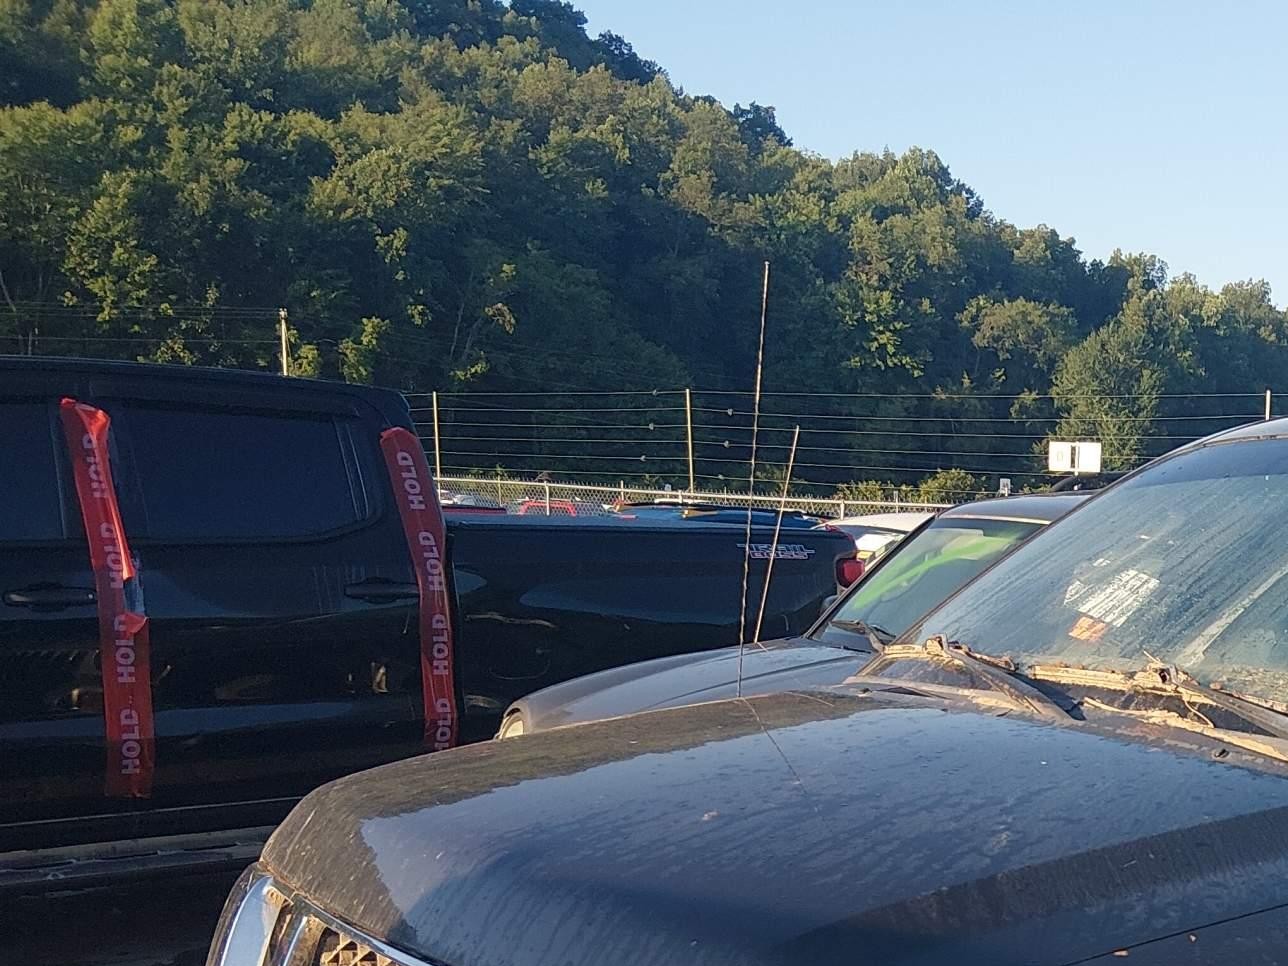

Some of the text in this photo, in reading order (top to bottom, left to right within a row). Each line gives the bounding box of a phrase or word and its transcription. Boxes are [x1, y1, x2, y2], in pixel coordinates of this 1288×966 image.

[397, 451, 426, 511] HOLD
[418, 531, 444, 592] HOLD
[431, 614, 449, 676] HOLD
[120, 708, 141, 775] HOLD
